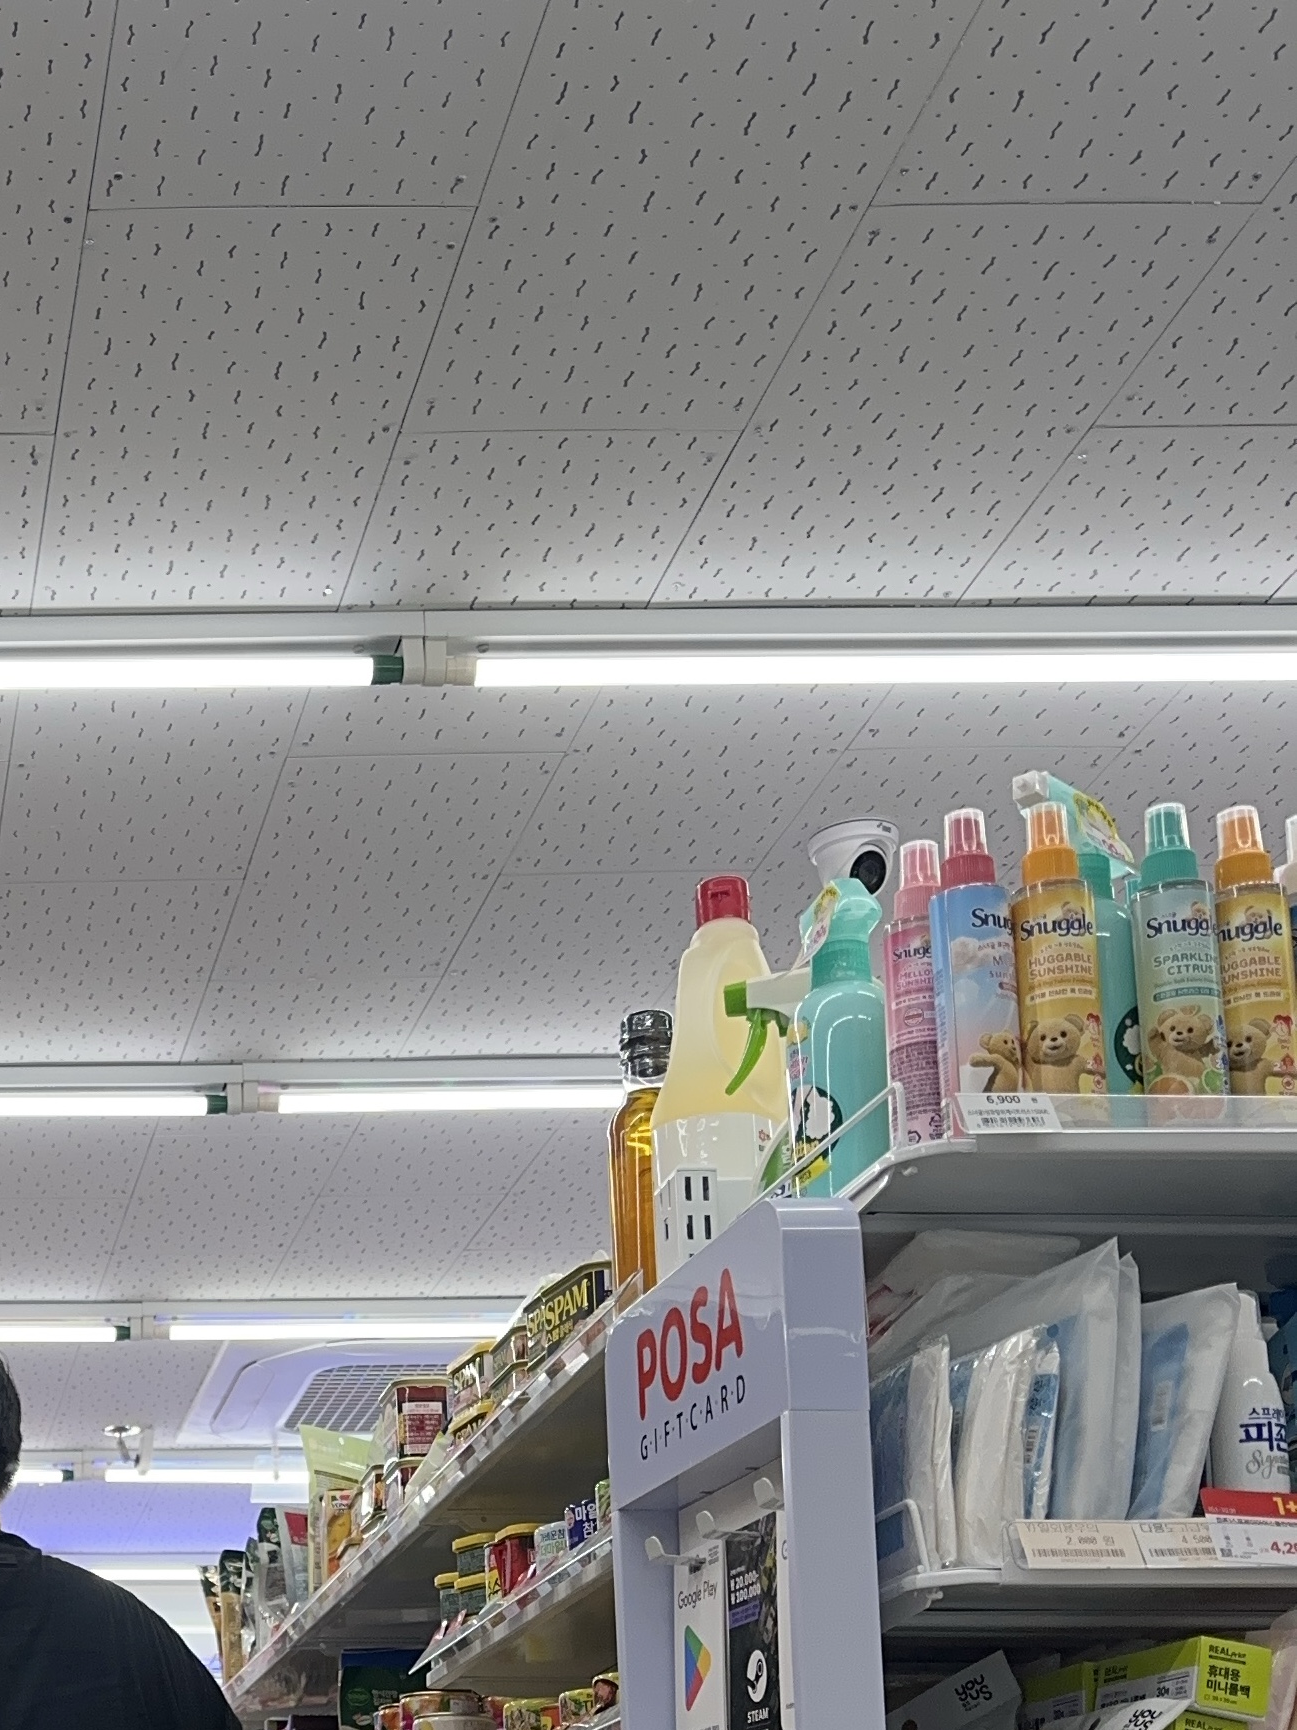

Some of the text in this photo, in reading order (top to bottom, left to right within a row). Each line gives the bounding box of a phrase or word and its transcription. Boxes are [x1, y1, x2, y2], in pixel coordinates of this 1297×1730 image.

[971, 907, 1014, 936] Snug
[1020, 912, 1093, 942] Snuggle
[1216, 916, 1283, 943] nuggle
[1028, 952, 1093, 969] HUGGABLE
[1030, 965, 1094, 980] SUNSHINE
[1167, 964, 1215, 977] CITRUS
[986, 1095, 1021, 1106] 6,900
[545, 1278, 590, 1332] SPAM
[528, 1304, 546, 1339] SPA
[636, 1268, 744, 1421] POSA
[575, 1502, 597, 1521] 마일
[677, 1580, 718, 1611] Google Play
[1208, 1644, 1231, 1657] REAL
[1208, 1664, 1242, 1681] 휴대용
[1206, 1679, 1250, 1698] 미니롤백
[747, 1707, 770, 1724] STEAM
[1185, 1718, 1206, 1730] REAL
